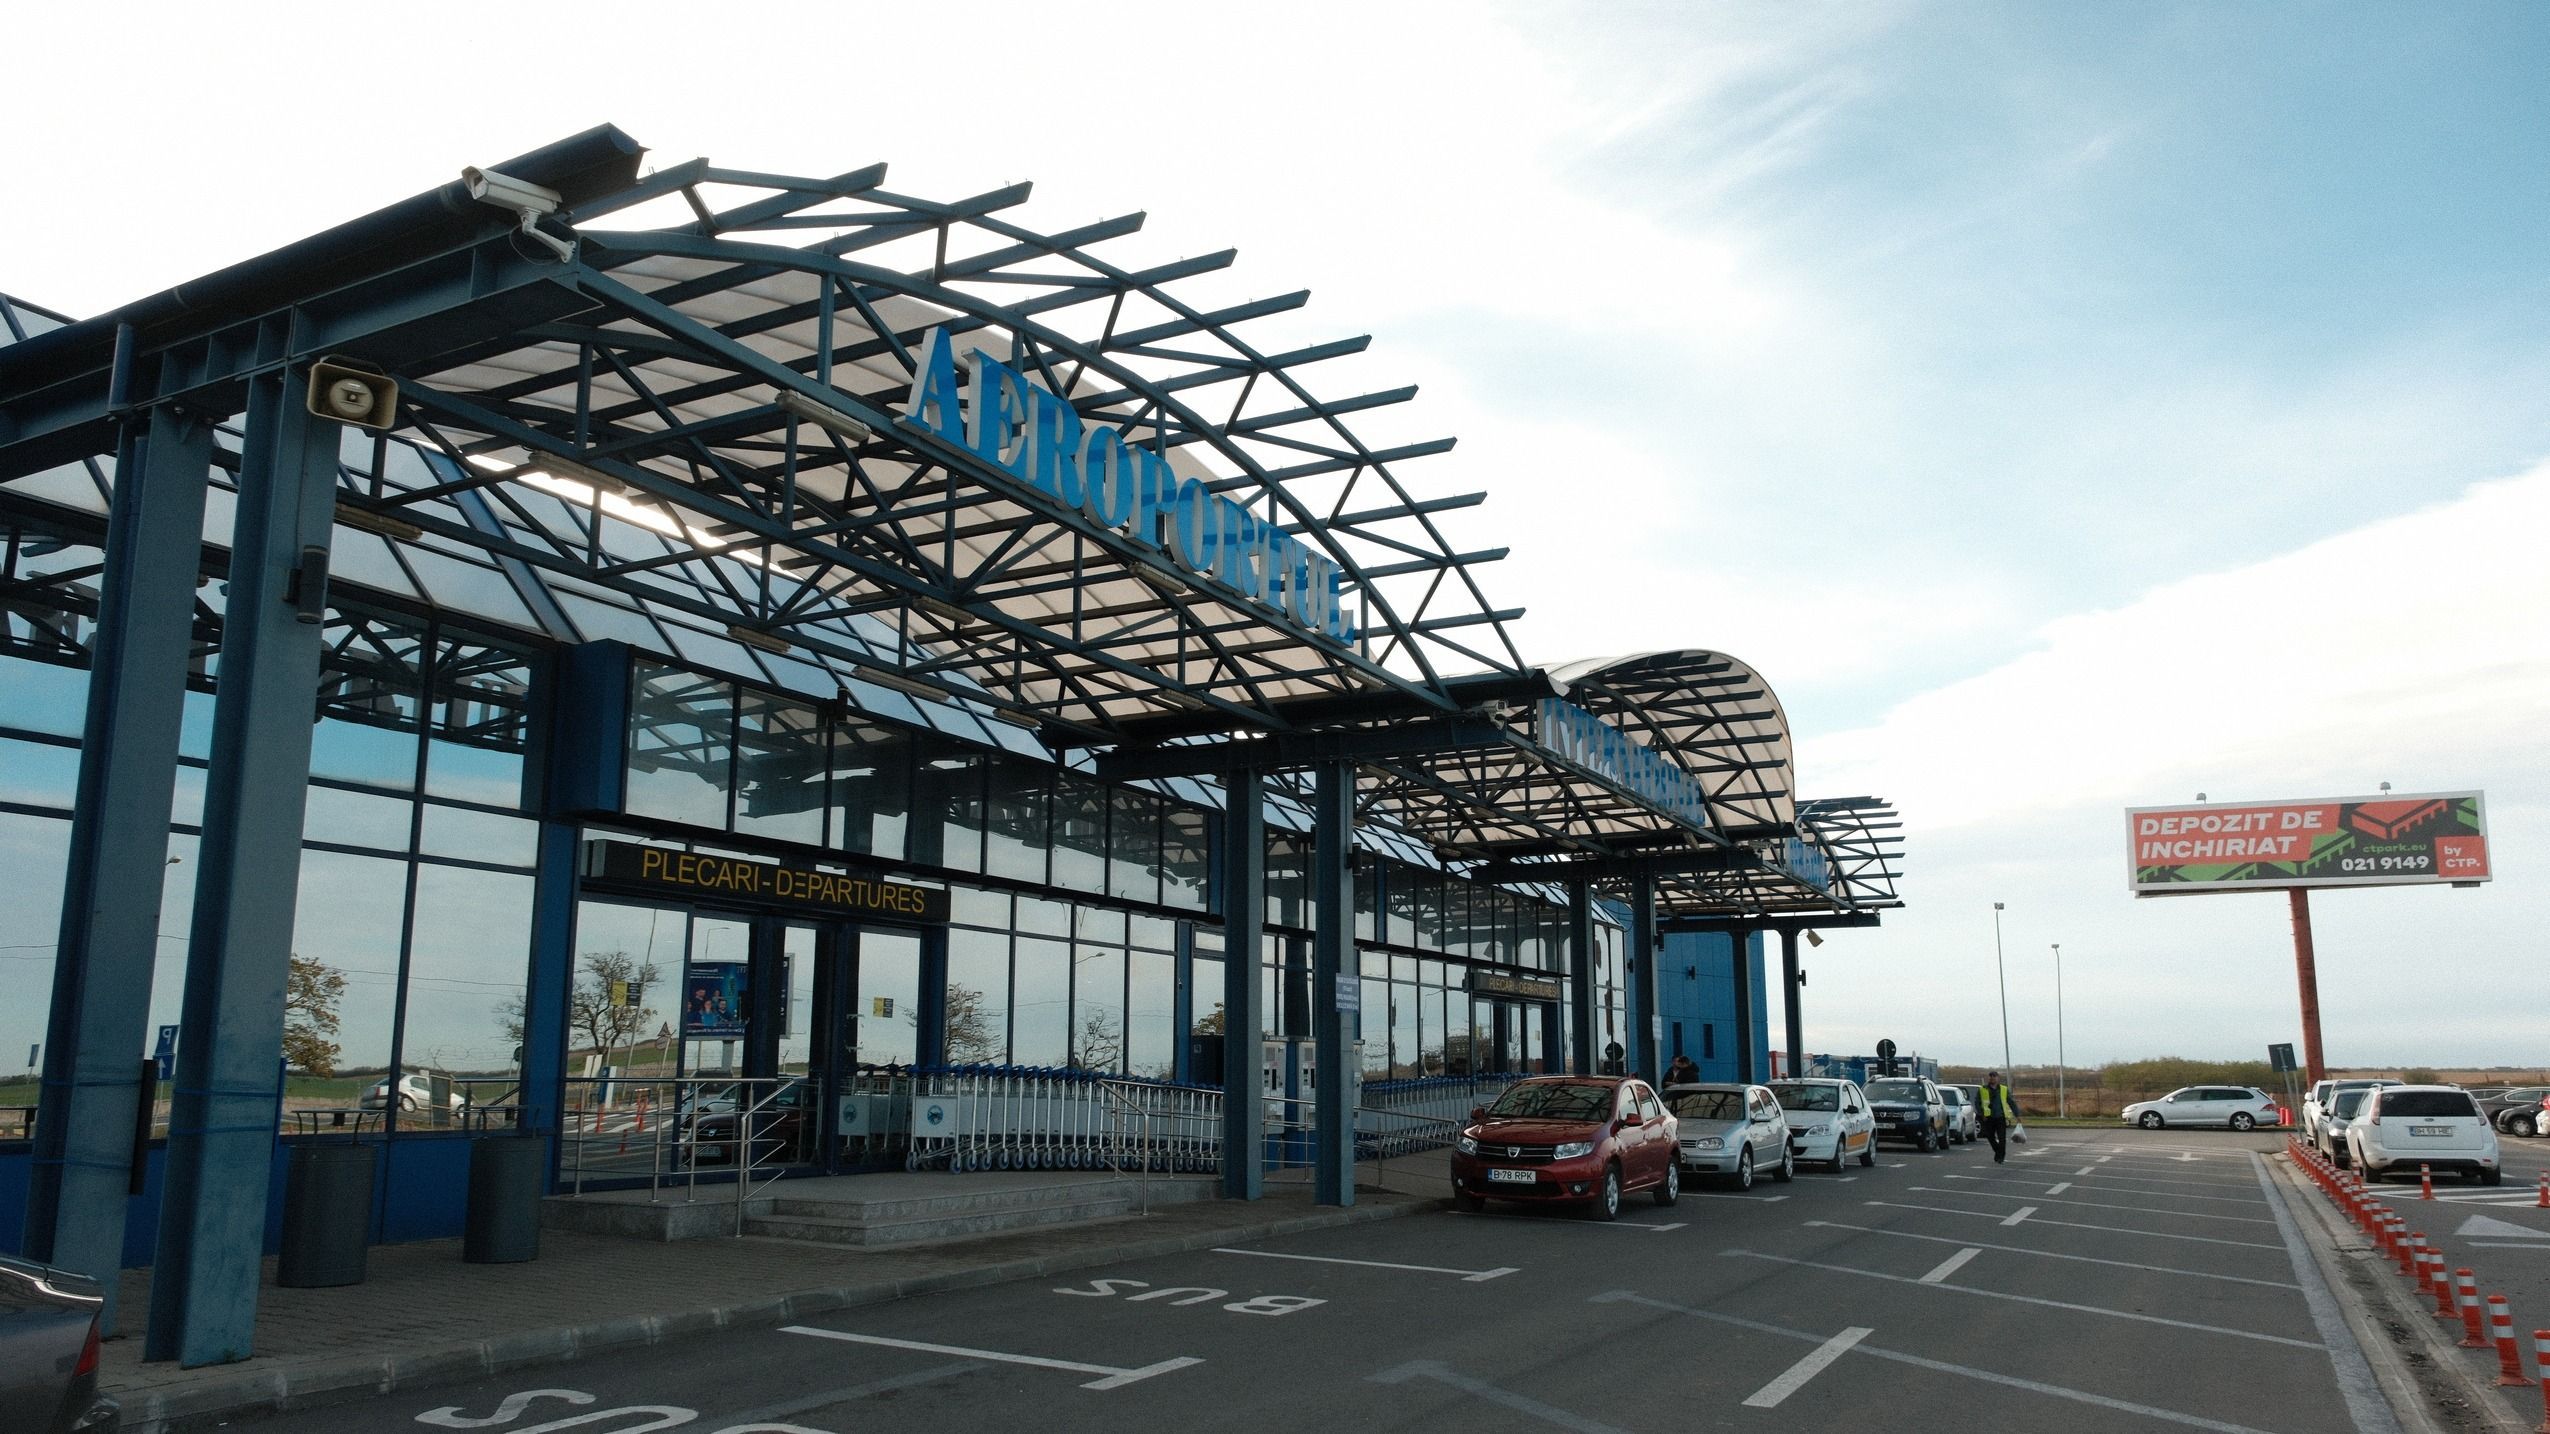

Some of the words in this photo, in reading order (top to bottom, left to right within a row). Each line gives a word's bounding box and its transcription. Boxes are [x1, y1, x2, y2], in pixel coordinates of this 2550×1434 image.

[895, 326, 1355, 648] AEROPORTUL
[2140, 812, 2273, 836] DEPOZIT
[2281, 810, 2323, 830] DE
[2141, 836, 2297, 860] INCHIRIAT
[2363, 843, 2427, 854] ctpark.eu
[2444, 846, 2461, 856] by
[2341, 857, 2375, 872] 021
[2380, 855, 2429, 870] 9149
[642, 850, 759, 892] PLECARI
[776, 870, 925, 914] DEPARTURES
[1493, 1170, 1500, 1179] B
[1502, 1170, 1512, 1180] 78
[1515, 1171, 1532, 1181] RPK
[1052, 1279, 1328, 1316] BUS
[414, 1389, 838, 1434] US
